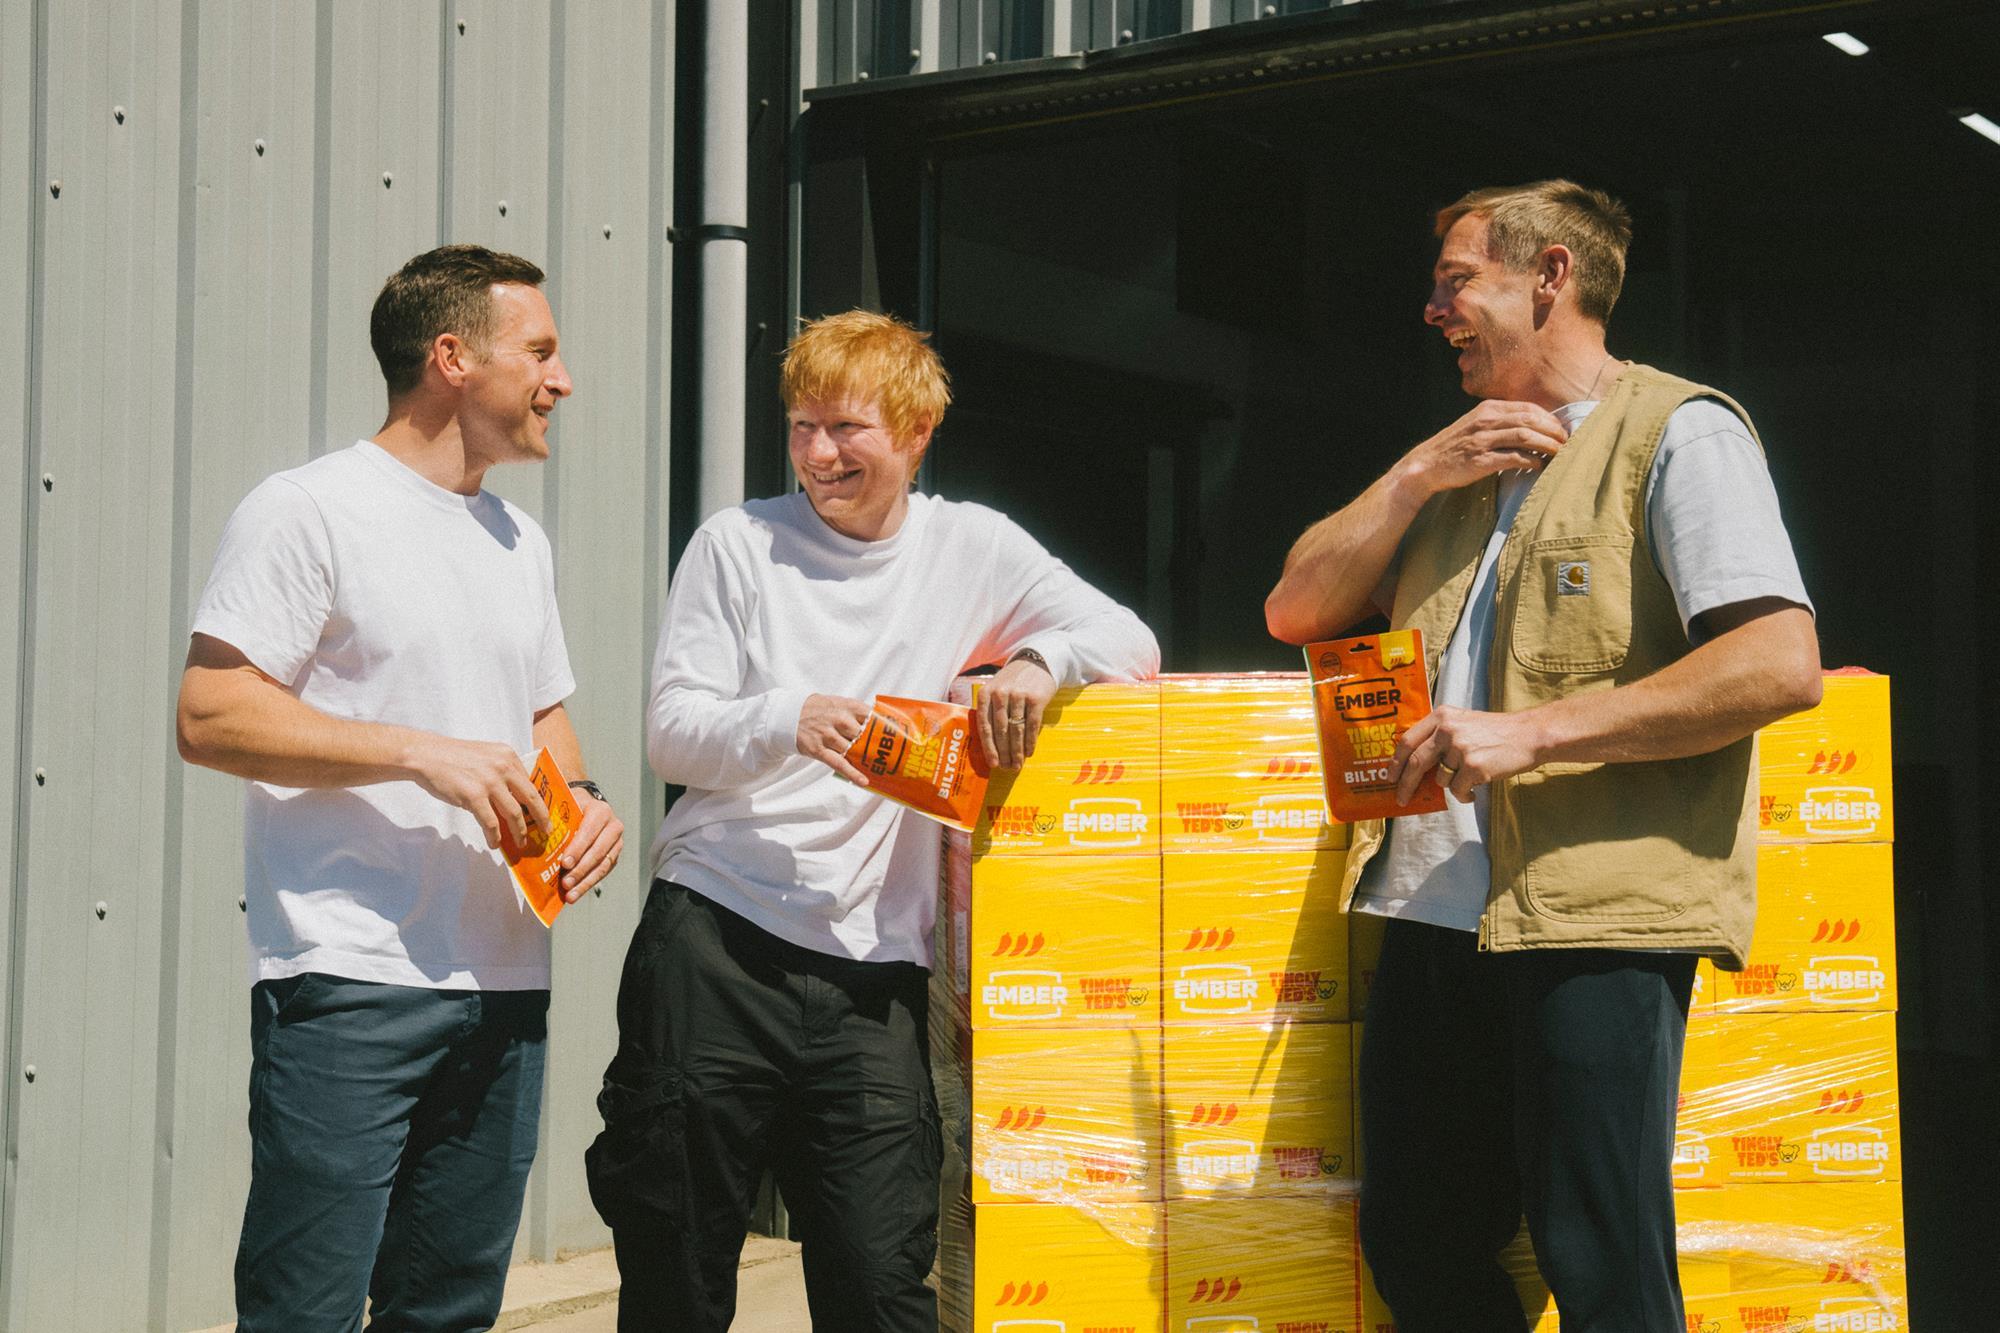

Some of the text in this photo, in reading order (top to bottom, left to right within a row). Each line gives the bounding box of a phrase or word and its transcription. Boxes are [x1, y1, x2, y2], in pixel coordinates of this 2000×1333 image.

[1334, 689, 1402, 711] EMBER
[1346, 723, 1397, 743] TINGLY
[1352, 741, 1396, 759] TED'S
[937, 728, 964, 799] BILTONG
[1344, 768, 1389, 783] BILTO
[987, 806, 1039, 821] TINGLY
[1177, 803, 1229, 816] TINGLY
[1800, 802, 1881, 820] EMBER
[992, 822, 1034, 836] TED'S
[1063, 813, 1148, 832] EMBER
[1182, 818, 1224, 833] TED'S
[1080, 978, 1132, 993] TINGLY
[1269, 972, 1322, 987] TINGLY
[1734, 980, 1775, 994] TED'S
[1803, 971, 1886, 990] EMBER
[982, 986, 1068, 1005] EMBER
[1174, 980, 1258, 999] EMBER
[1275, 987, 1316, 1002] TED'S
[1085, 995, 1126, 1009] TED'S
[1732, 1137, 1783, 1151] TINGLY
[1806, 1142, 1888, 1161] EMBER
[1273, 1148, 1325, 1163] TINGLY
[1738, 1152, 1779, 1167] TED'S
[1176, 1155, 1260, 1174] EMBER
[1739, 1307, 1790, 1321] TINGLY
[1814, 1313, 1898, 1333] EMBER
